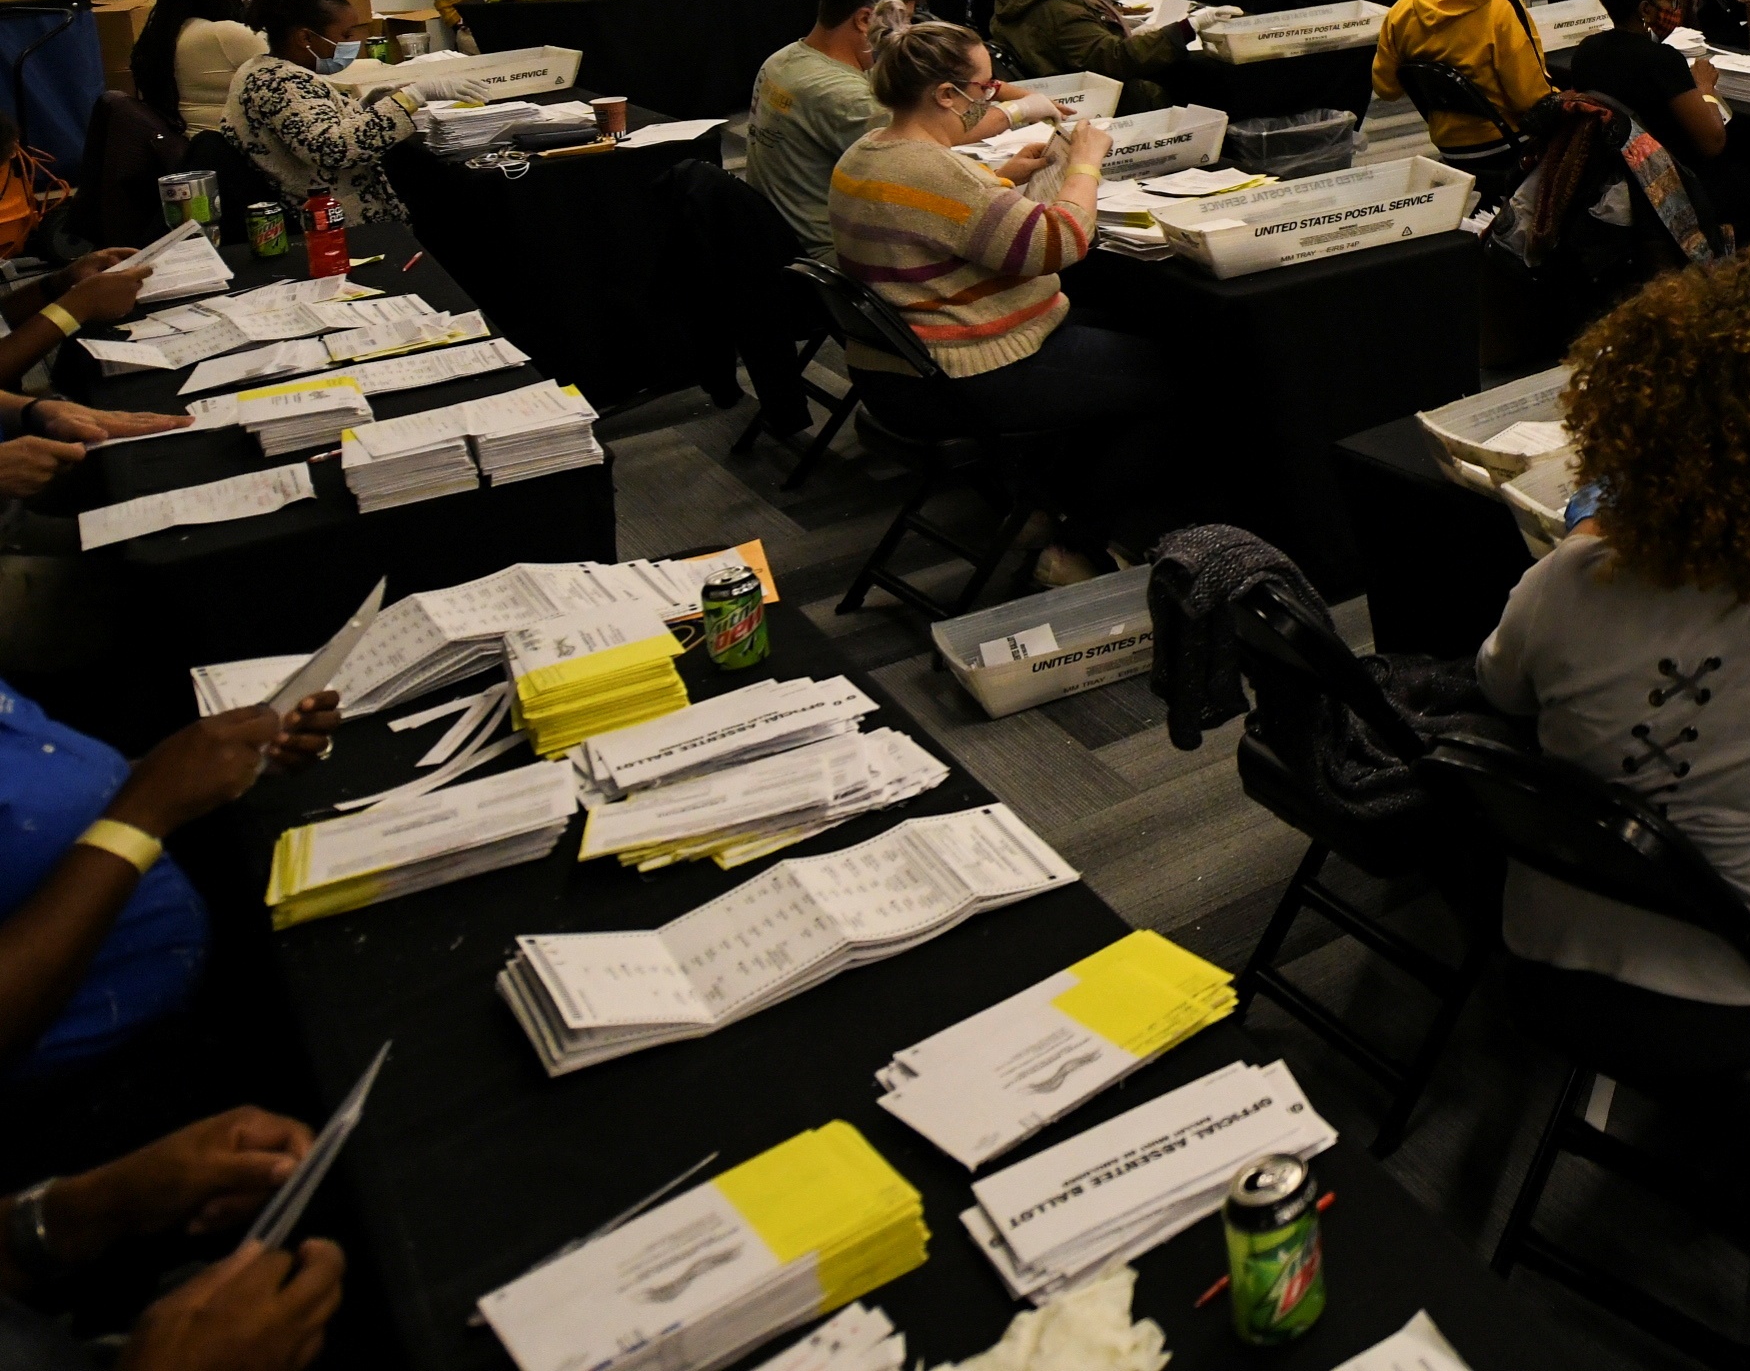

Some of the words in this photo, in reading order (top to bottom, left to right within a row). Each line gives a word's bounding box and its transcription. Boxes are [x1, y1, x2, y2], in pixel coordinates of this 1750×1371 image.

[1257, 31, 1285, 41] UNITED
[1285, 28, 1313, 37] STATES
[1314, 24, 1341, 34] POSTAL
[1342, 18, 1371, 29] SERVICE
[1553, 20, 1575, 30] UNITED
[1574, 16, 1596, 26] STATES
[1595, 13, 1610, 22] POST
[481, 75, 508, 84] STAL
[510, 68, 549, 81] SERVICE
[1055, 94, 1085, 105] ERVICE
[1115, 142, 1153, 156] POSTAL
[1154, 132, 1193, 149] SERVICE
[1102, 158, 1134, 168] WARNING
[1254, 220, 1298, 238] UNITED
[1299, 212, 1343, 230] STATES
[1344, 204, 1387, 221] POSTAL
[1388, 192, 1435, 211] SERVICE
[1280, 254, 1295, 263] MM
[1295, 250, 1317, 260] TRAY
[1032, 650, 1083, 673] UNITED
[1085, 636, 1136, 658] STATES
[1063, 683, 1080, 694] MM
[1082, 677, 1105, 689] TRAY
[764, 701, 826, 724] OFFICIAL
[679, 723, 757, 752] ABSENTEE
[615, 750, 675, 771] BALLOT
[1197, 1096, 1274, 1140] OFFICIAL
[1091, 1138, 1189, 1189] ABSENTEE
[1009, 1184, 1085, 1230] BALLOT
